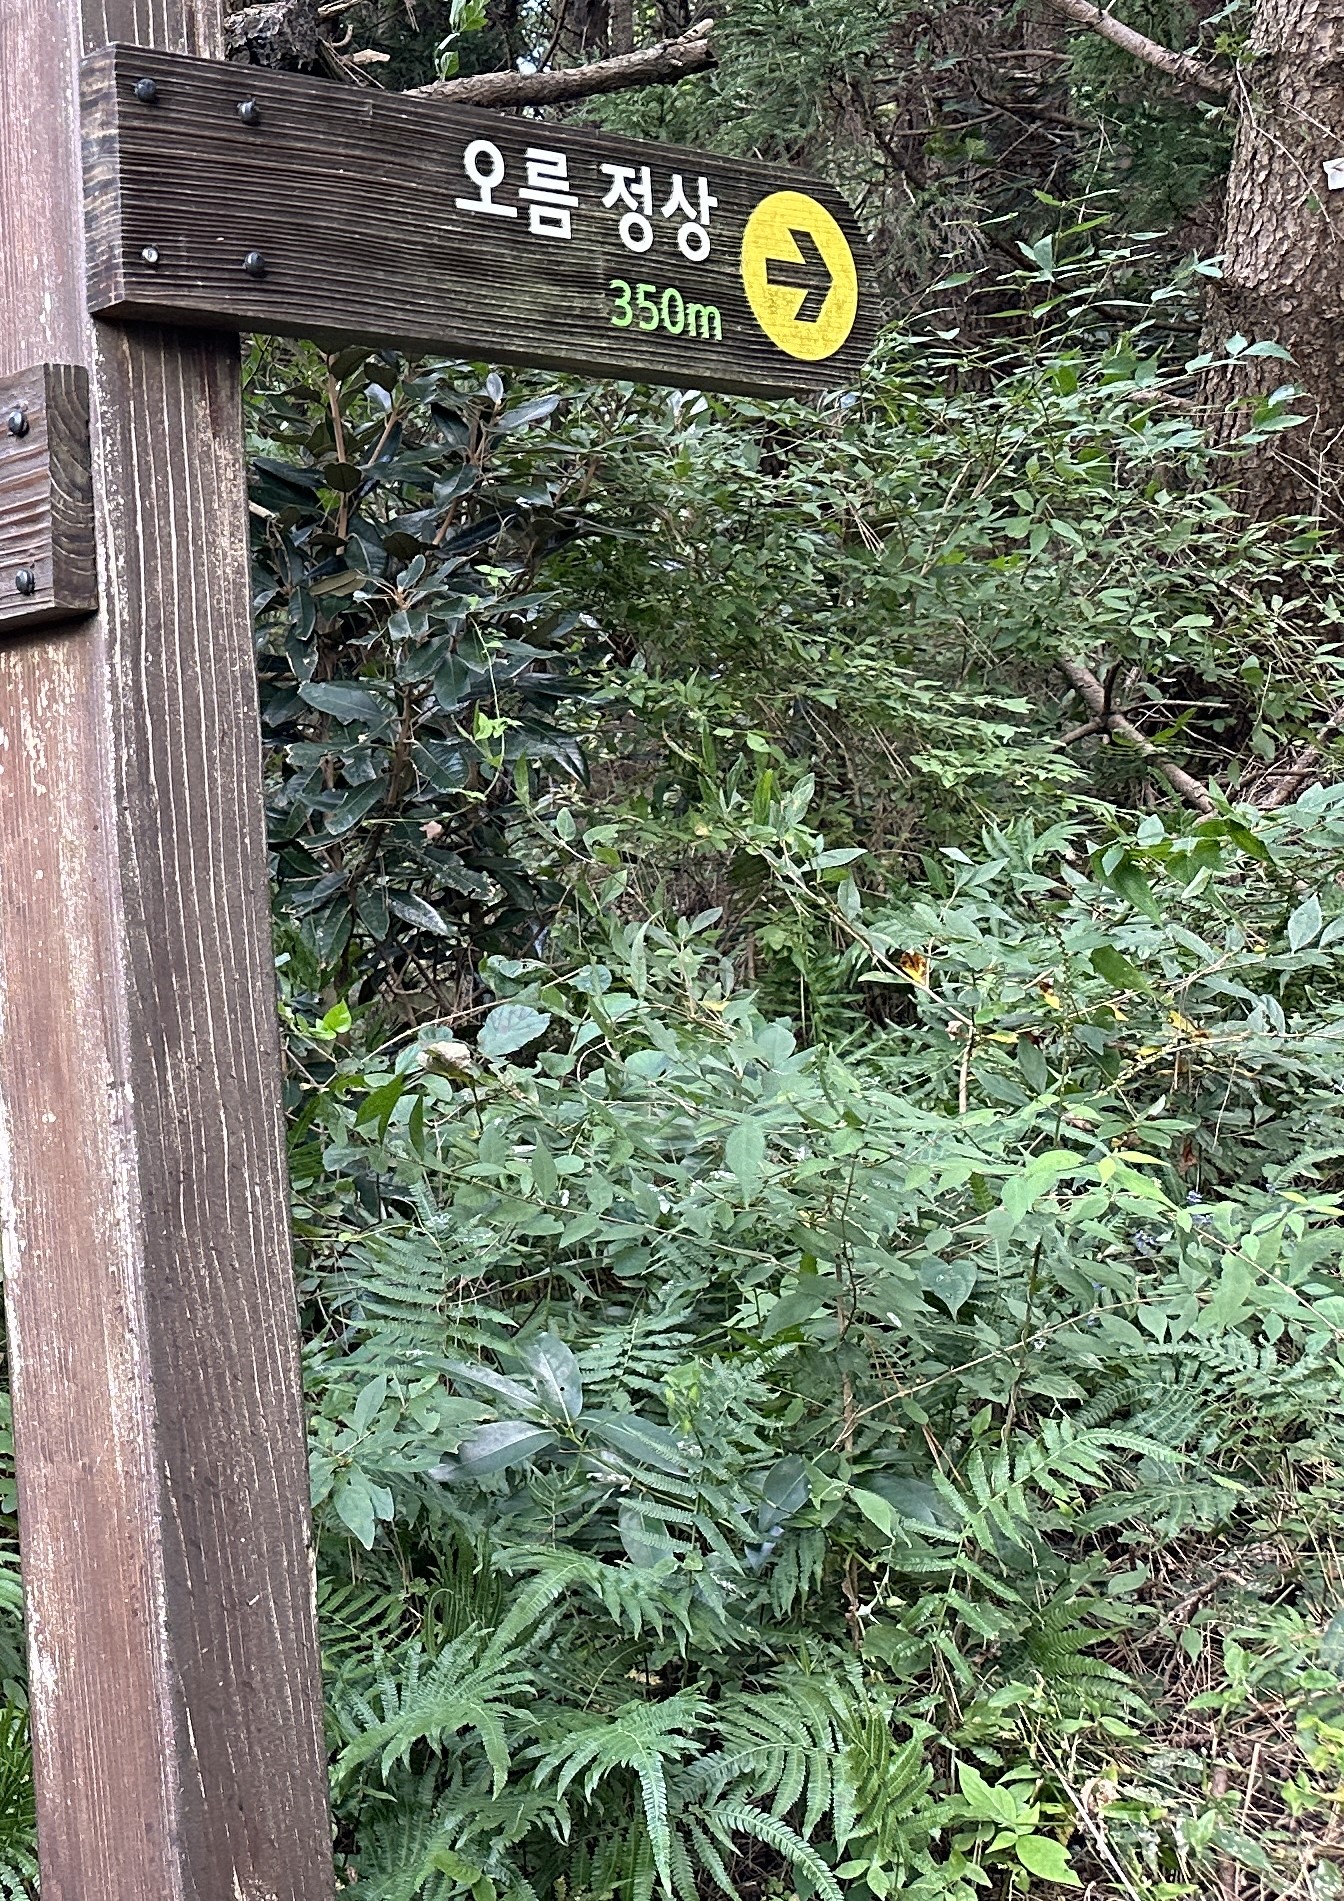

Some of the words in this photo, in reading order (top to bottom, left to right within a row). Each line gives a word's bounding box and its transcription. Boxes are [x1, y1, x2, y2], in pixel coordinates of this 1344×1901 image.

[455, 138, 580, 240] 오름
[599, 162, 719, 262] 정상
[608, 279, 723, 341] 350m
